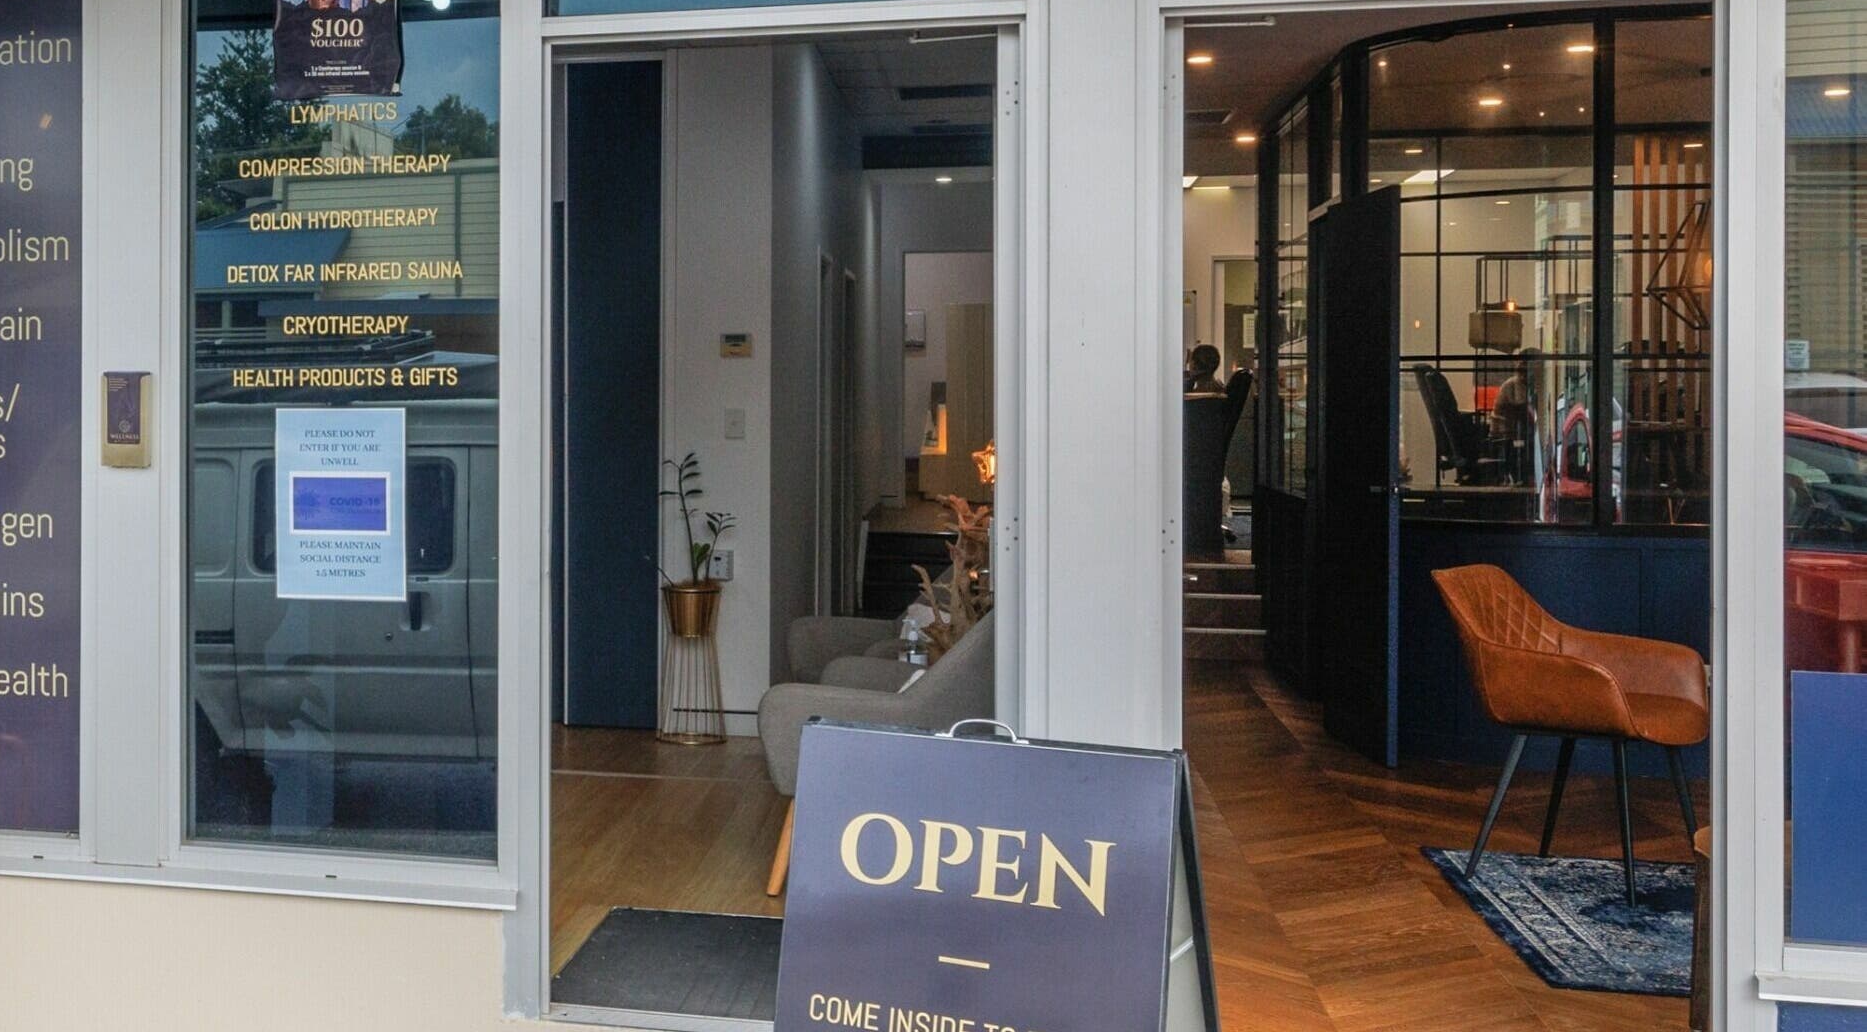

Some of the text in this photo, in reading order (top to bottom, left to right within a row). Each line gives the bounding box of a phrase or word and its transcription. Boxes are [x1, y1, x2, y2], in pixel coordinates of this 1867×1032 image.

[310, 18, 364, 39] $100
[290, 102, 398, 125] LYMPHATICS
[238, 154, 451, 179] COMPRESSION THERAPY
[249, 207, 438, 231] COLON HYDROTHERAPY
[227, 260, 463, 284] DETOX FAR INFRARED SAUNA
[283, 315, 409, 336] CRYOTHERAPY
[233, 367, 458, 388] HEALTH PRODUCTS & GIFTS
[304, 429, 376, 438] PLEASE DO NOT
[299, 443, 381, 453] ENTER IF YOU ARE
[321, 457, 359, 466] UNWELL
[300, 540, 381, 550] PLEASE MAINTAIN
[300, 554, 381, 564] SOCIAL DISTANCE
[328, 568, 366, 578] METRES
[840, 812, 1117, 917] OPEN
[809, 993, 881, 1031] COME
